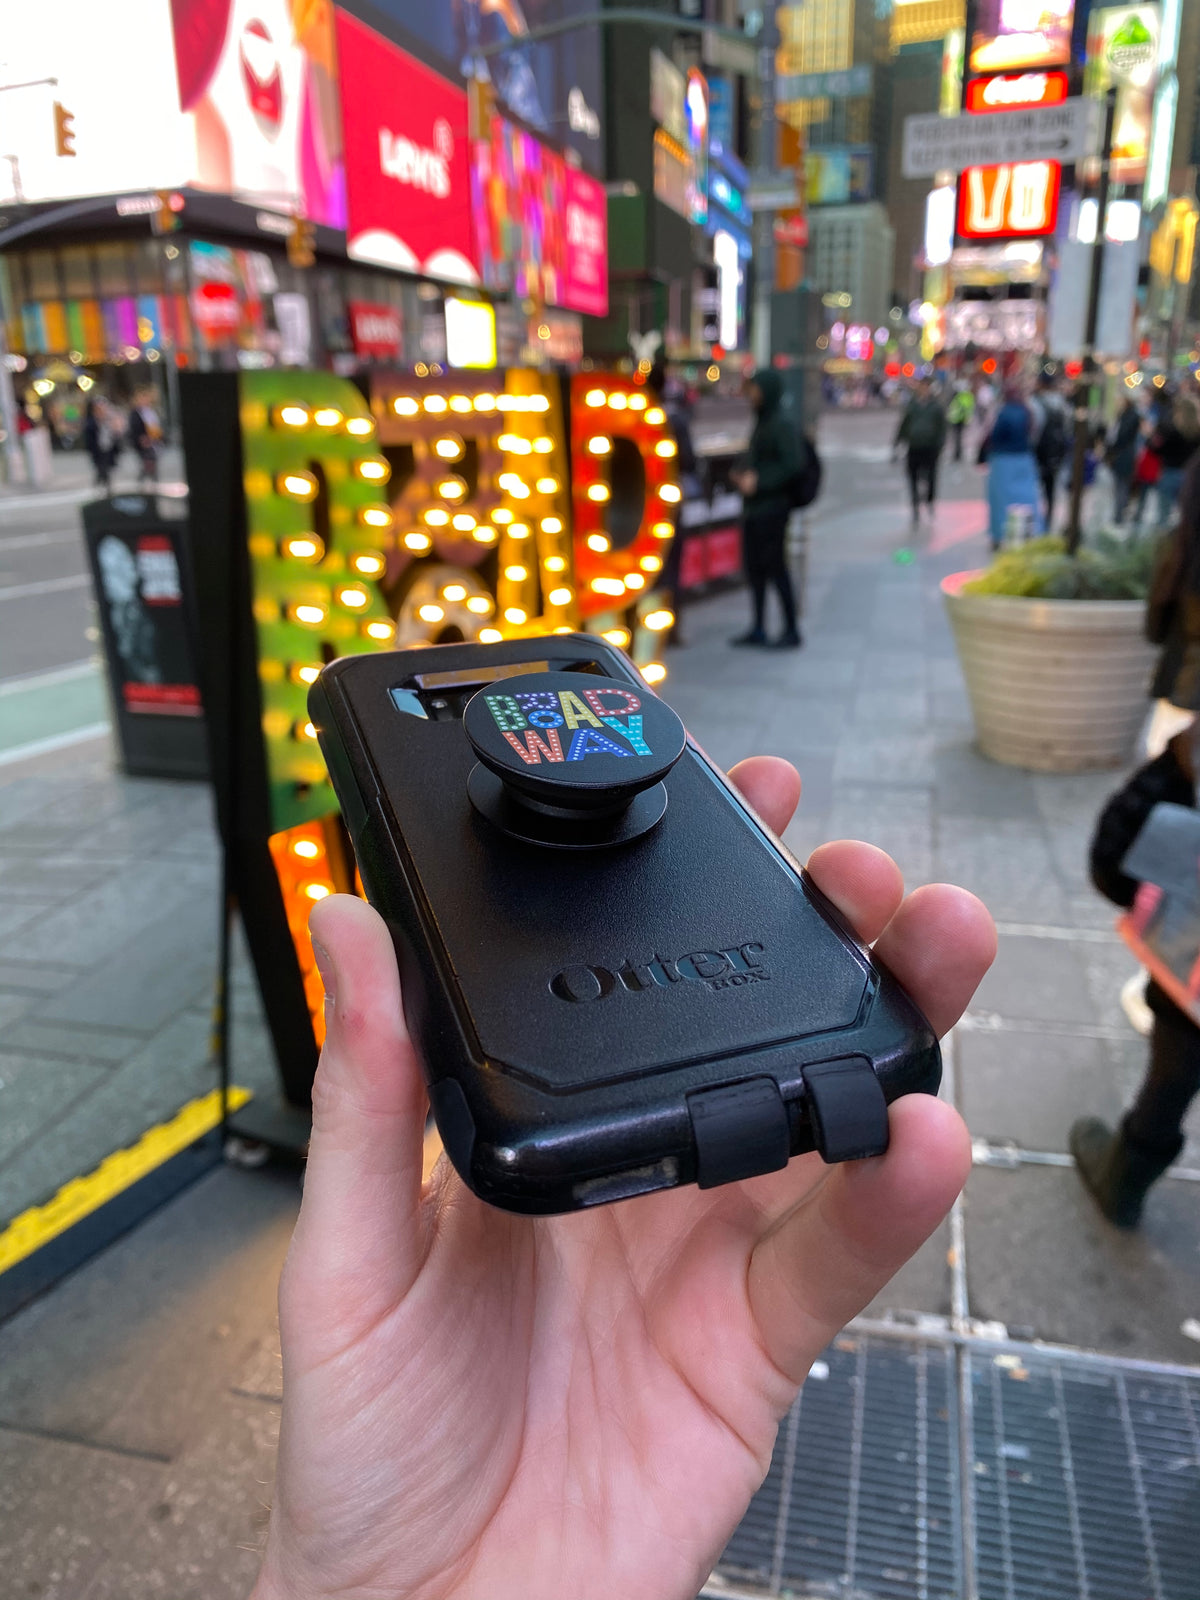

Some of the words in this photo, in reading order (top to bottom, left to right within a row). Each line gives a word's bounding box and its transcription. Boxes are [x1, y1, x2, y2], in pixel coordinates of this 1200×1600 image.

[484, 689, 642, 732] BROAD
[502, 715, 653, 765] WAY
[548, 941, 764, 1003] Otter
[704, 970, 770, 992] BOX
